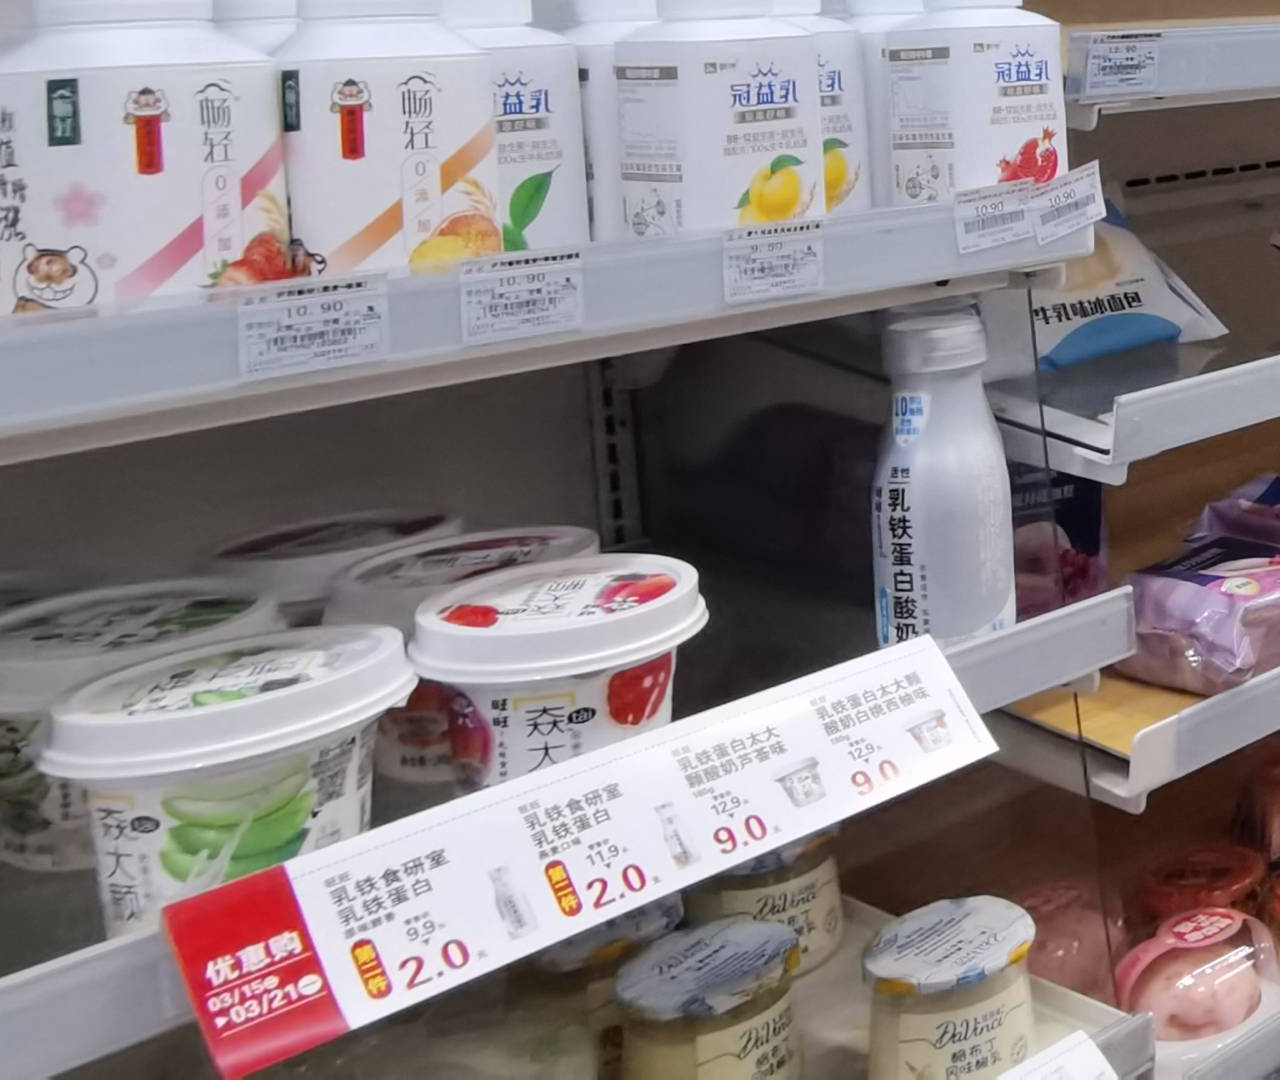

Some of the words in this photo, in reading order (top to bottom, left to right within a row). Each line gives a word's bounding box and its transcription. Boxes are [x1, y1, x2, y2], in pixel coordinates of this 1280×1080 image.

[995, 60, 1050, 84] 冠益乳
[492, 88, 554, 117] 益乳
[730, 79, 799, 108] 冠益乳
[975, 200, 1004, 218] 10.90
[1048, 189, 1077, 209] 10.90
[286, 300, 344, 319] 10.90
[1032, 290, 1145, 325] 牛乳味冰面包
[887, 487, 919, 644] 乳铁蛋白酸奶
[491, 698, 509, 729] 旺旺
[677, 726, 781, 773] 乳铁蛋白太大
[684, 741, 789, 789] 颗酸奶芦荟味
[848, 743, 876, 761] 12.9
[523, 782, 625, 831] 乳铁食研室
[711, 795, 742, 816] 12.9
[530, 807, 612, 849] 乳铁蛋白
[713, 814, 768, 854] 9.0
[586, 843, 620, 866] 11.9
[329, 848, 450, 908] 乳铁食研室
[587, 863, 647, 911] 2.0
[337, 878, 433, 927] 乳铁蛋白
[405, 919, 436, 941] 9.9
[205, 930, 303, 988] 优惠购
[399, 938, 470, 991] 2.0
